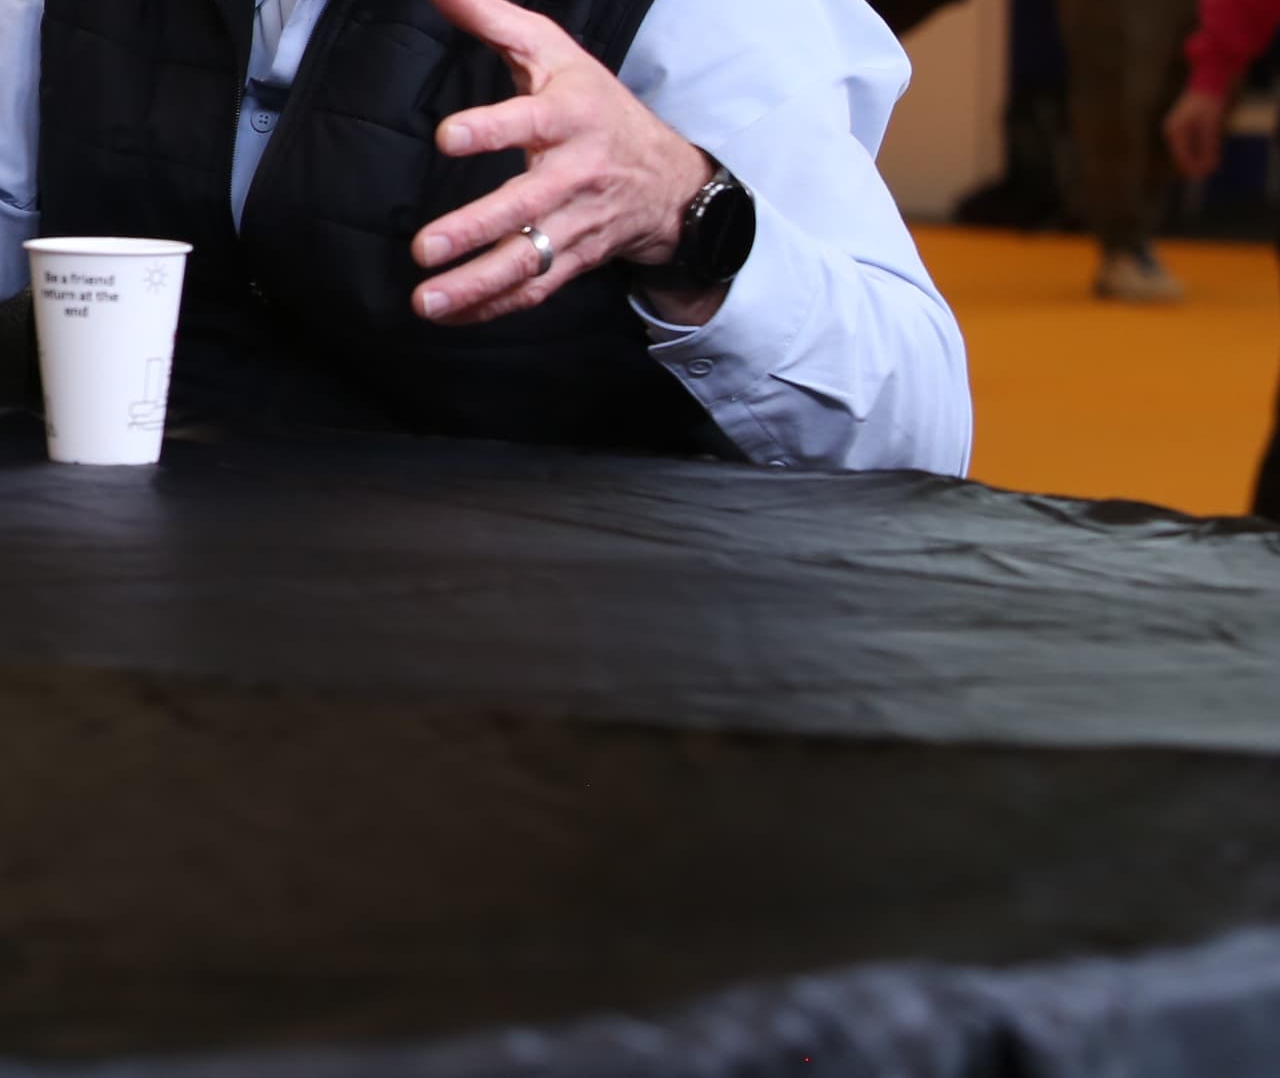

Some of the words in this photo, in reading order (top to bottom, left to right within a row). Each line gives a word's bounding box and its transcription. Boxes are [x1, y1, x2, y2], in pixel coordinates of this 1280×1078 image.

[45, 271, 57, 283] Be
[70, 273, 115, 286] friend
[42, 289, 74, 300] return
[80, 290, 92, 301] at
[96, 290, 119, 302] the
[64, 306, 88, 318] end
